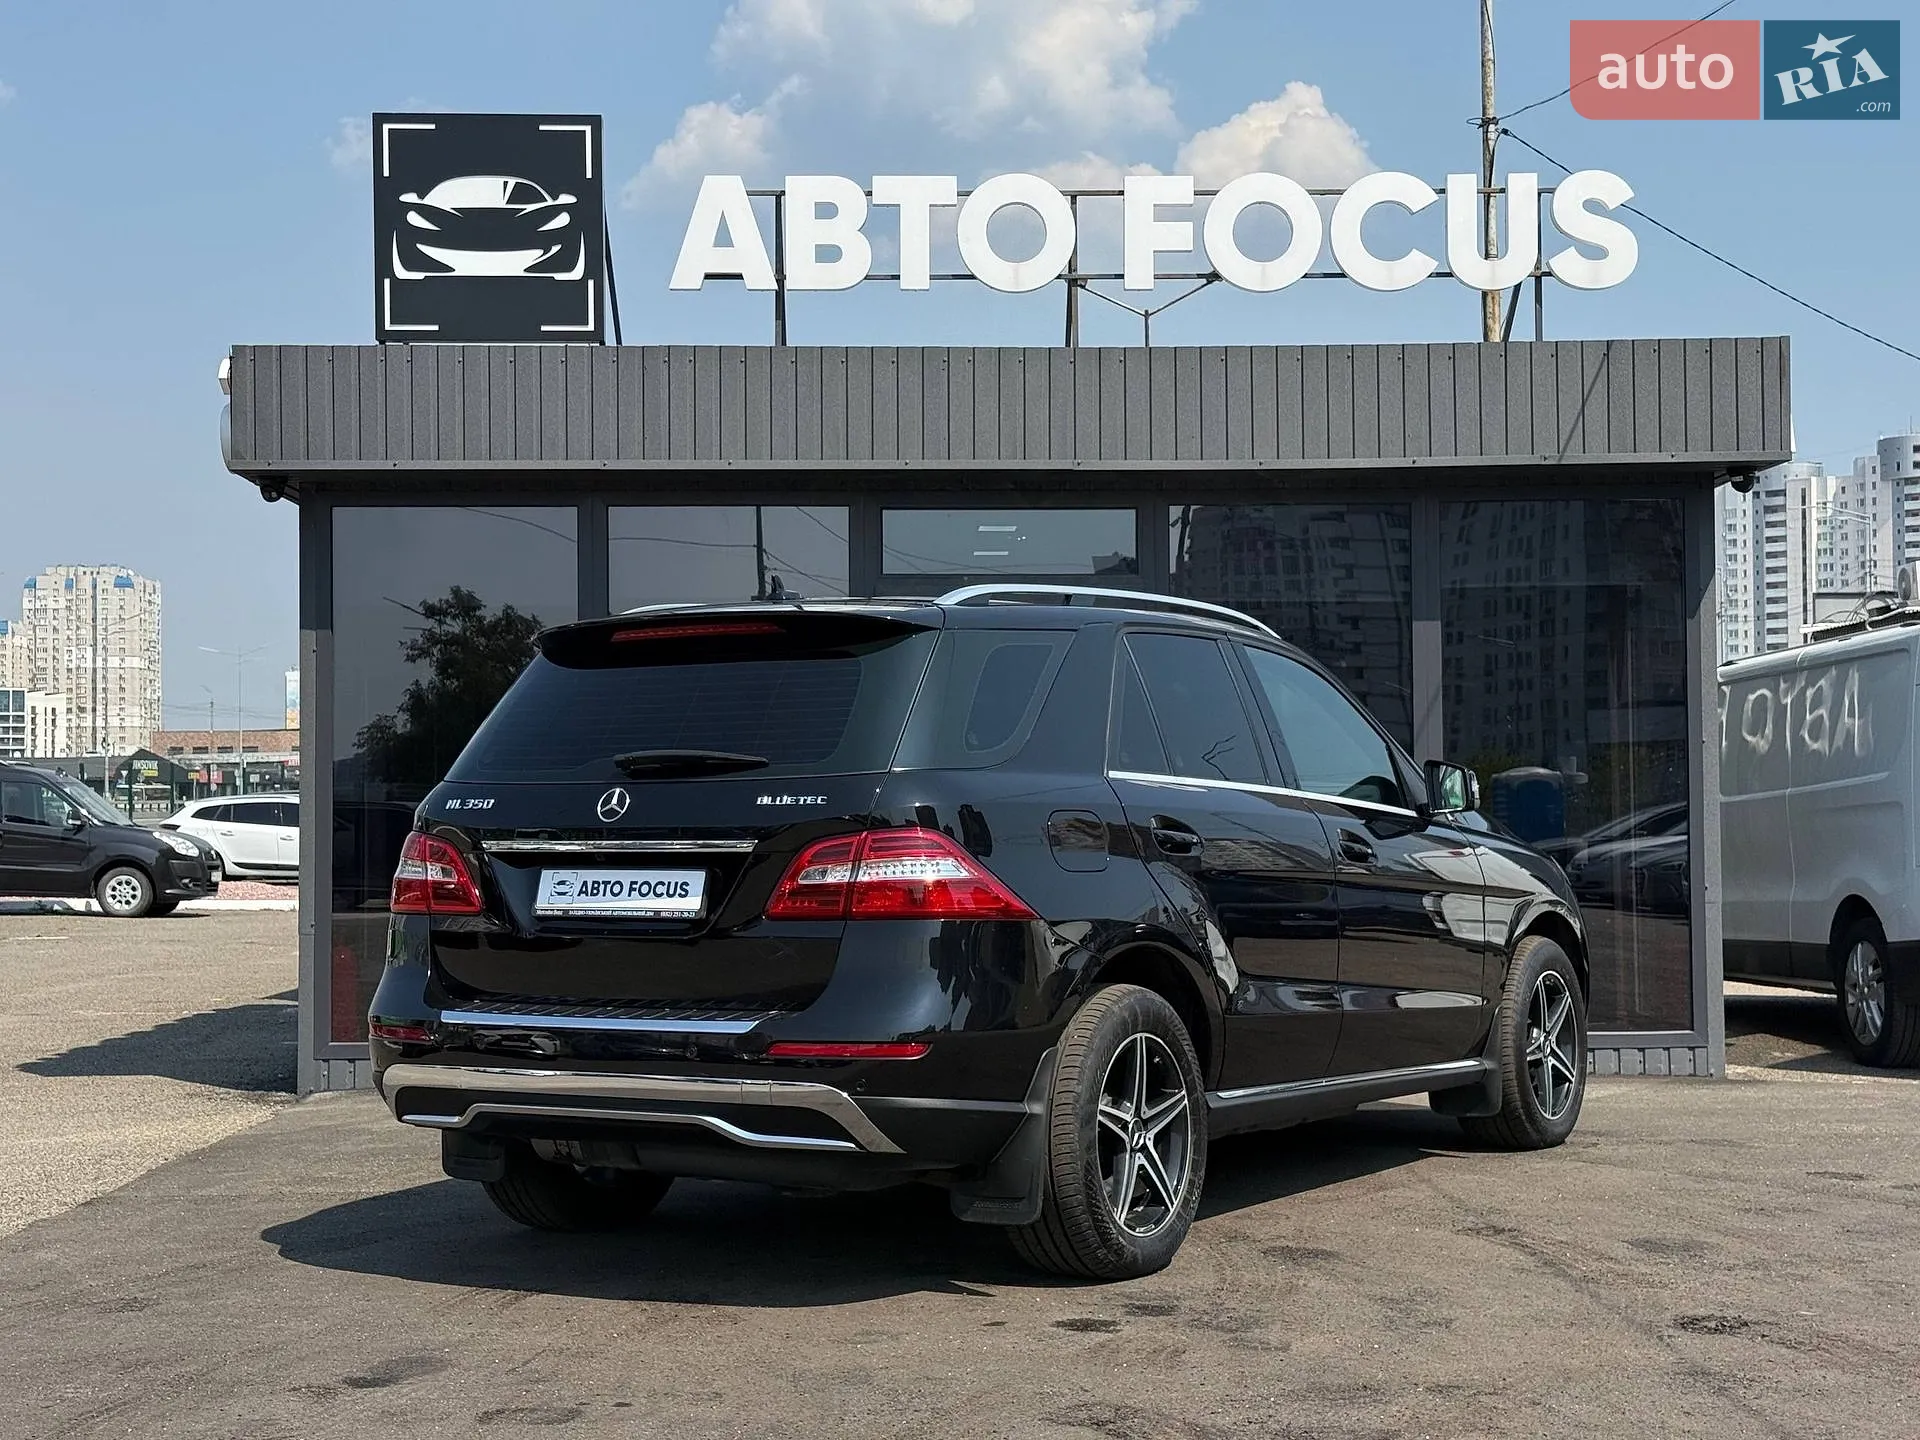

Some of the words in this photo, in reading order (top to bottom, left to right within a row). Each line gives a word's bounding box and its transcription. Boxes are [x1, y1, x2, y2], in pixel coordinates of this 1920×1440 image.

[669, 173, 1077, 292] АВТО
[1123, 171, 1639, 292] FOCUS
[756, 795, 827, 805] BLUETEC
[577, 880, 624, 898] АВТО
[628, 880, 690, 898] FOCUS
